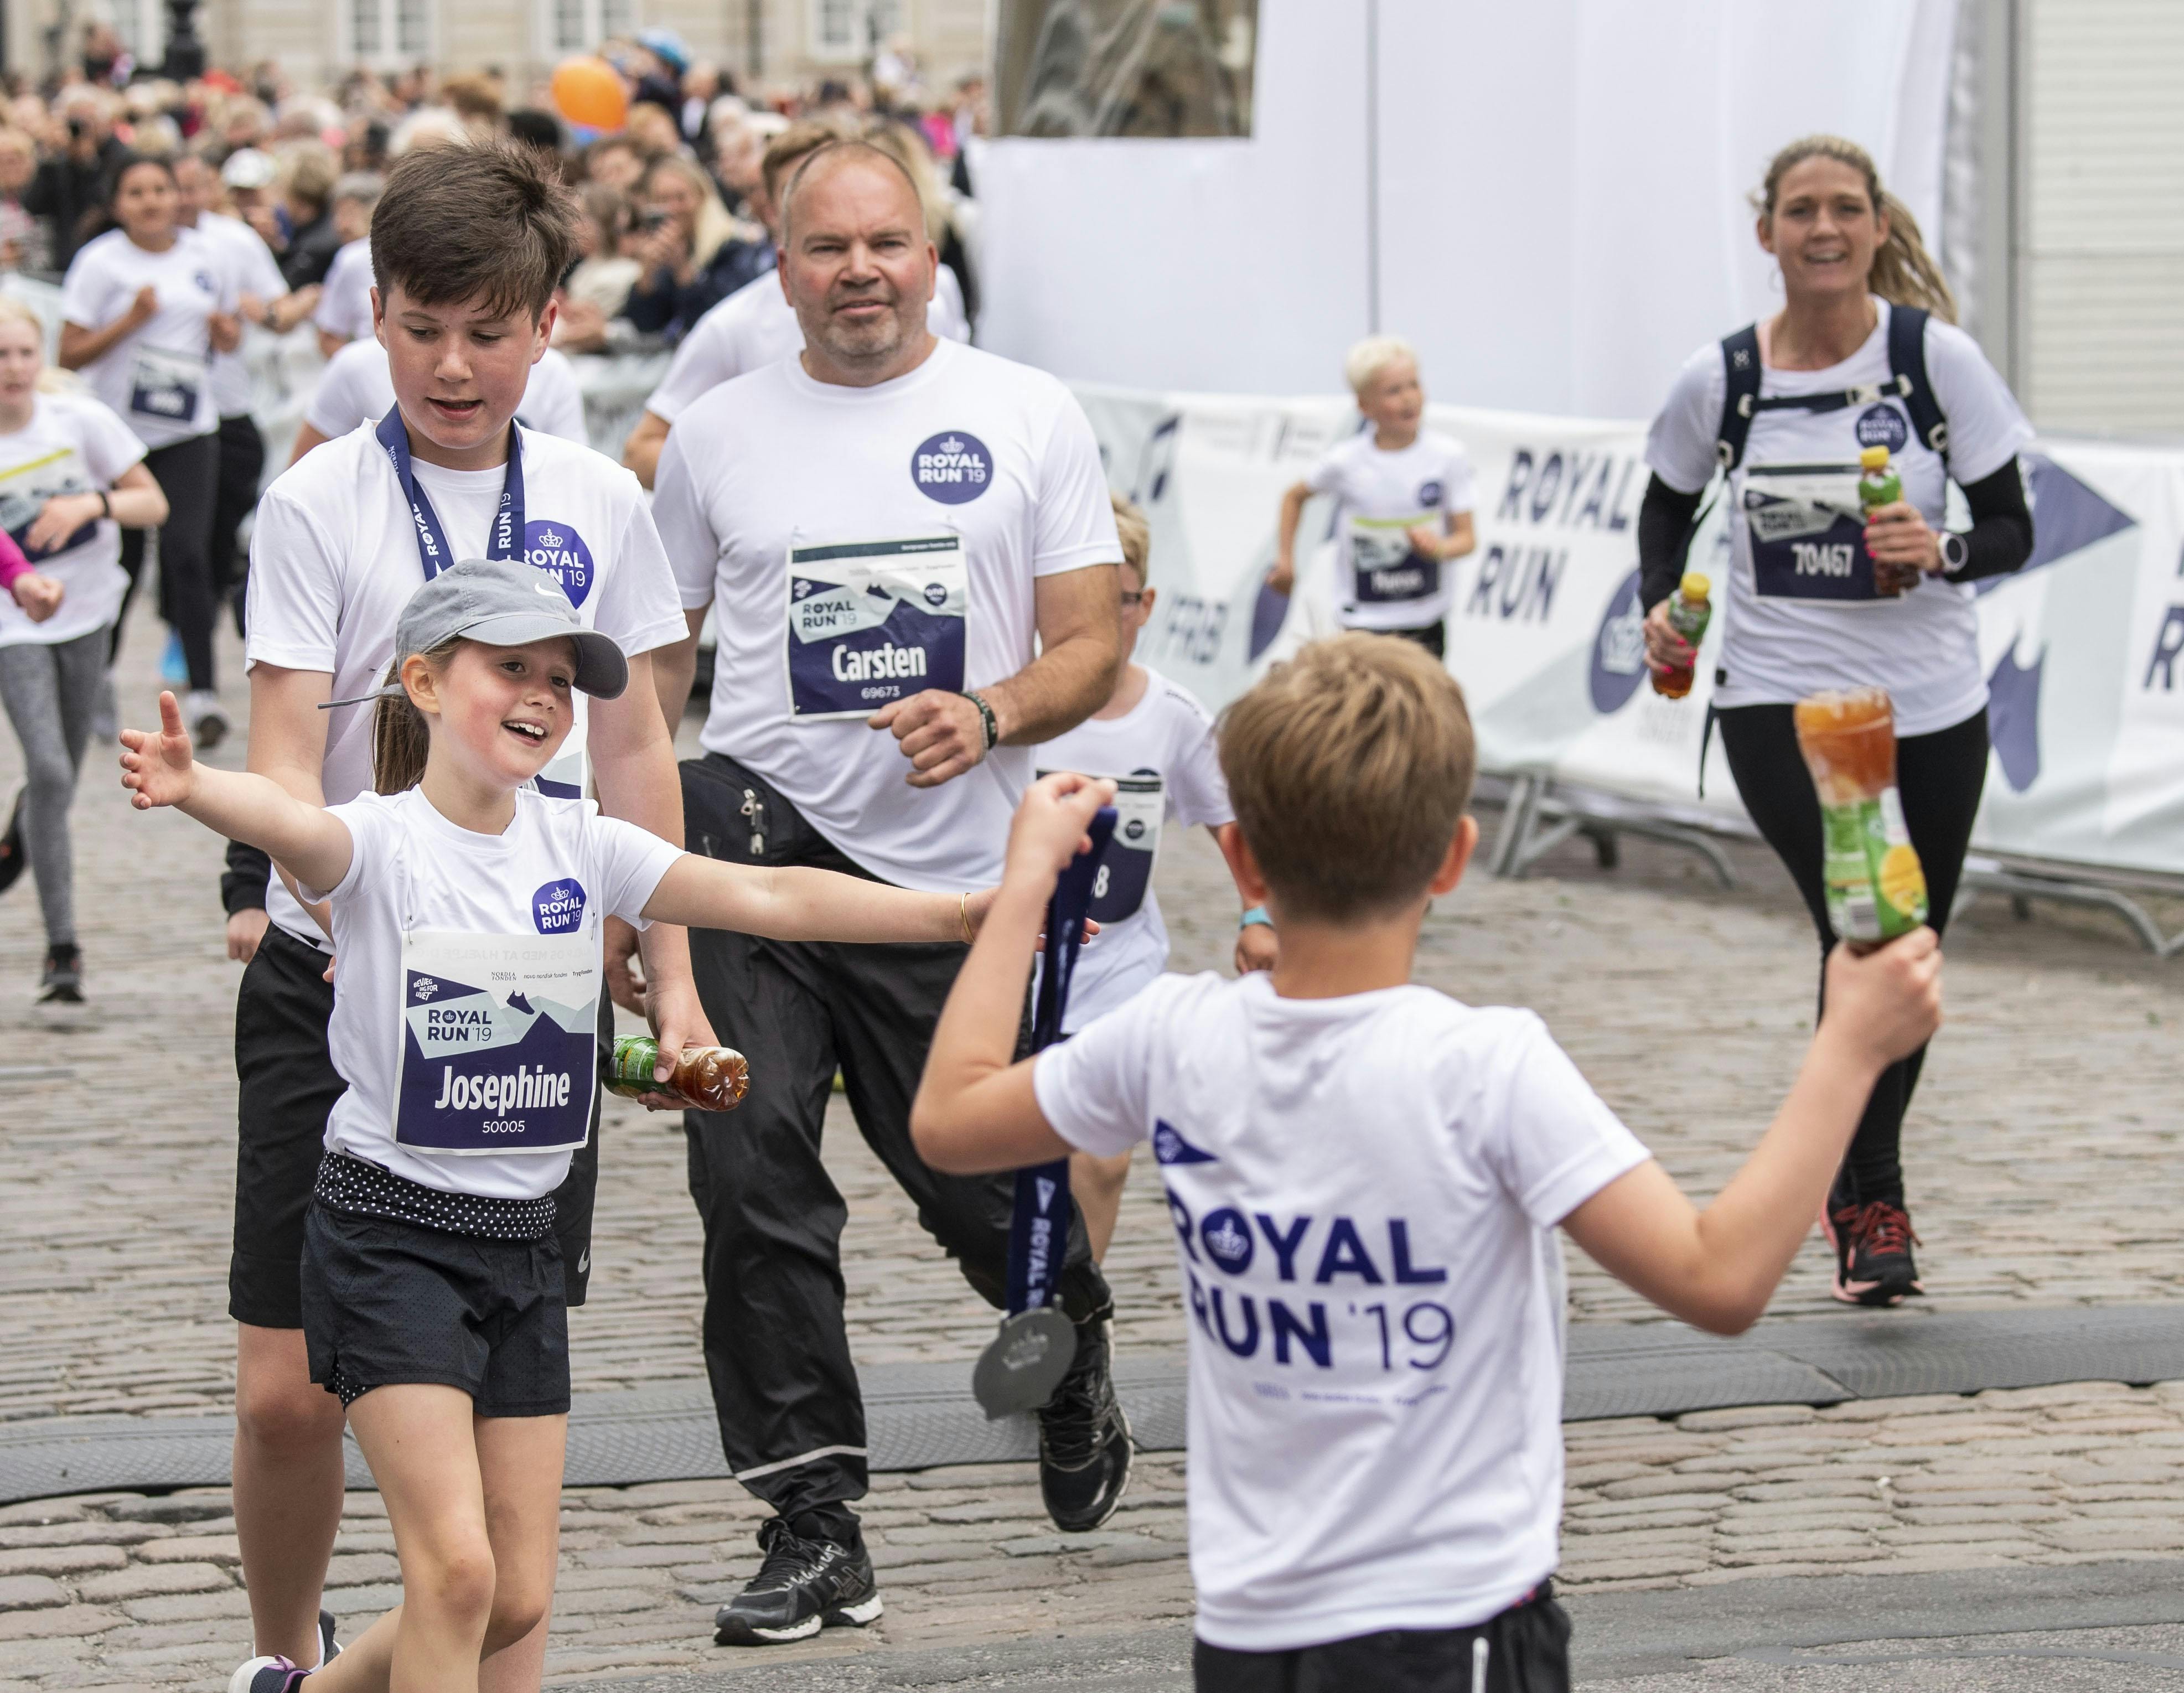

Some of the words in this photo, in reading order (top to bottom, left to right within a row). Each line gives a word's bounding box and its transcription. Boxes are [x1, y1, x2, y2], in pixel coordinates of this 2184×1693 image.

[918, 453, 985, 468] ROYAL
[918, 468, 962, 483] RUN
[963, 468, 986, 484] '19
[1496, 449, 1636, 531] ROYAL
[500, 493, 511, 511] '19
[413, 503, 439, 556] ROYAL
[498, 511, 511, 549] RUN
[524, 548, 584, 569] ROYAL
[1790, 543, 1855, 577] 70467
[566, 569, 586, 587] '19
[1467, 542, 1569, 624] RUN
[803, 600, 855, 614] ROYAL
[803, 614, 837, 628] RUN
[832, 642, 927, 682] Carsten
[861, 685, 900, 700] 69673
[539, 897, 582, 915] ROYAL
[541, 913, 570, 929] RUN
[572, 969, 593, 977] TrygFonden
[413, 977, 433, 988] BEVÆG
[415, 991, 433, 1001] LIVET
[428, 1009, 493, 1024] ROYAL
[427, 1026, 469, 1041] RUN
[472, 1027, 492, 1042] '19
[434, 1064, 571, 1117] Josephine
[482, 1120, 525, 1133] 50005
[1166, 1185, 1448, 1285] ROYAL
[1026, 1217, 1052, 1287] ROYAL
[1188, 1268, 1333, 1369] RUN
[1347, 1301, 1455, 1371] '19
